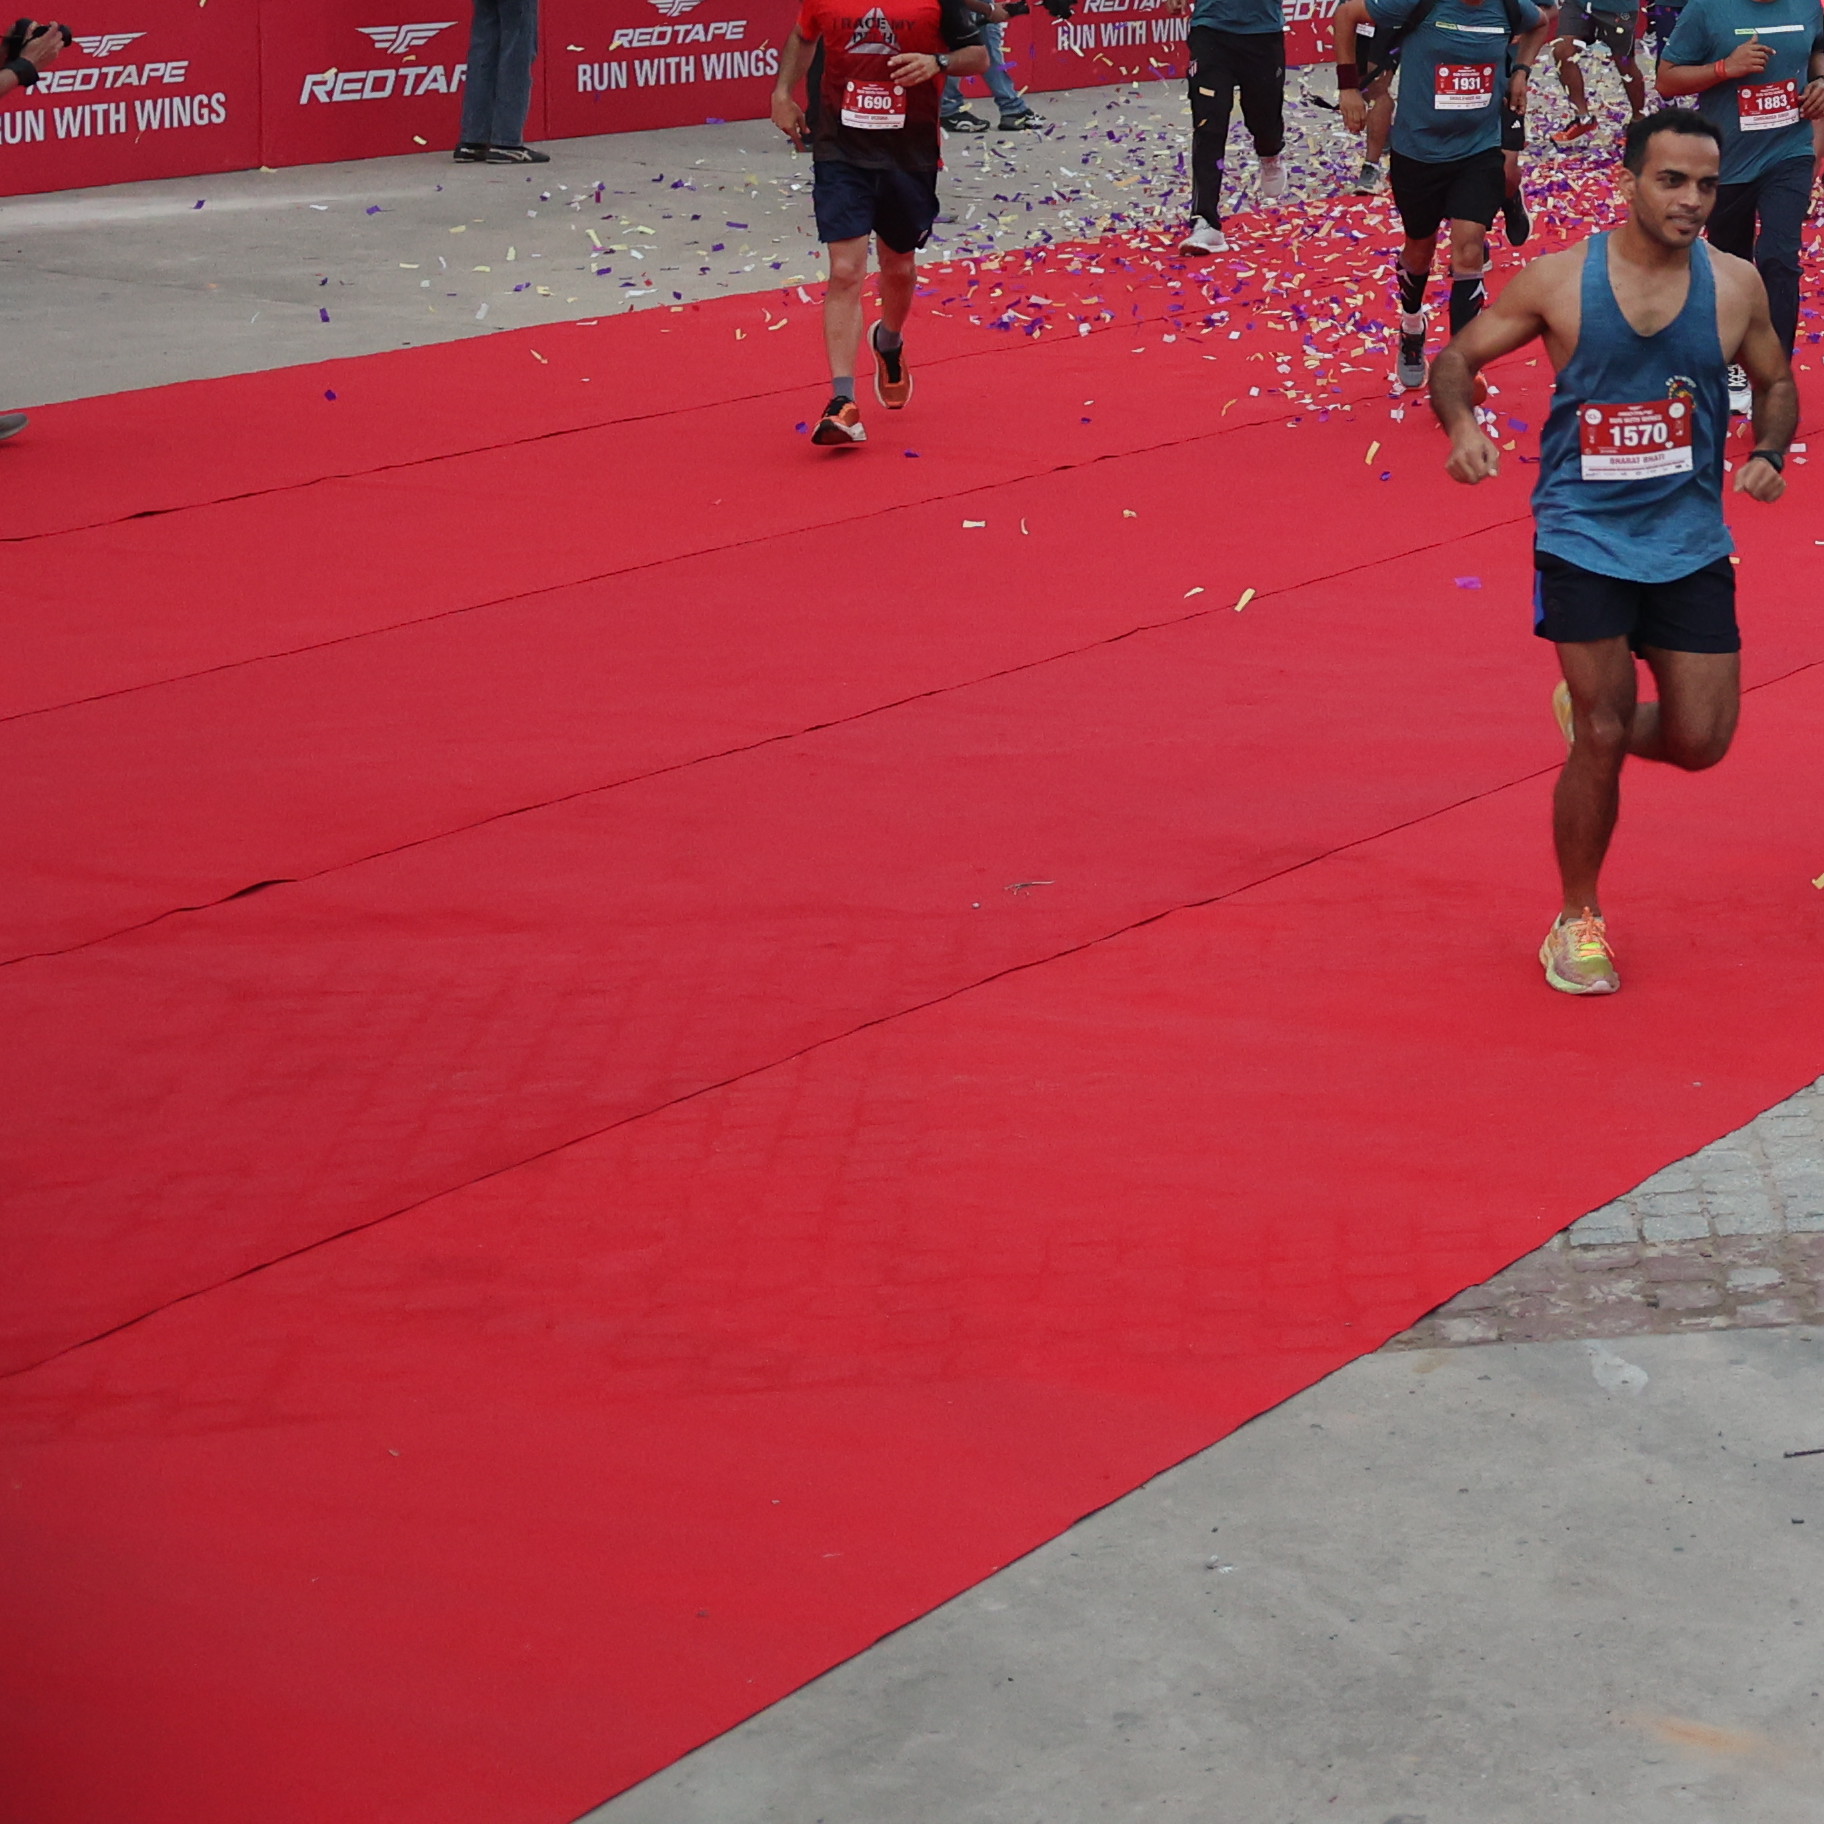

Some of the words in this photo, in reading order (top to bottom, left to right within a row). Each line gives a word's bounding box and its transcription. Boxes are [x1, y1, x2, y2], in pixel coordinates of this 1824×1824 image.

[613, 20, 748, 49] REDTAPE
[1099, 20, 1148, 49] WITH
[1150, 16, 1190, 48] WIN
[25, 60, 190, 96] REDTAPE
[300, 64, 468, 105] REDTAP
[577, 61, 628, 94] RUN
[634, 55, 696, 89] WITH
[702, 47, 780, 82] WINGS
[1452, 76, 1481, 91] 1931
[54, 101, 127, 140] WITH
[135, 92, 227, 133] WINGS
[855, 94, 893, 111] 1690
[1755, 93, 1788, 111] 1883
[1609, 422, 1668, 447] 1570
